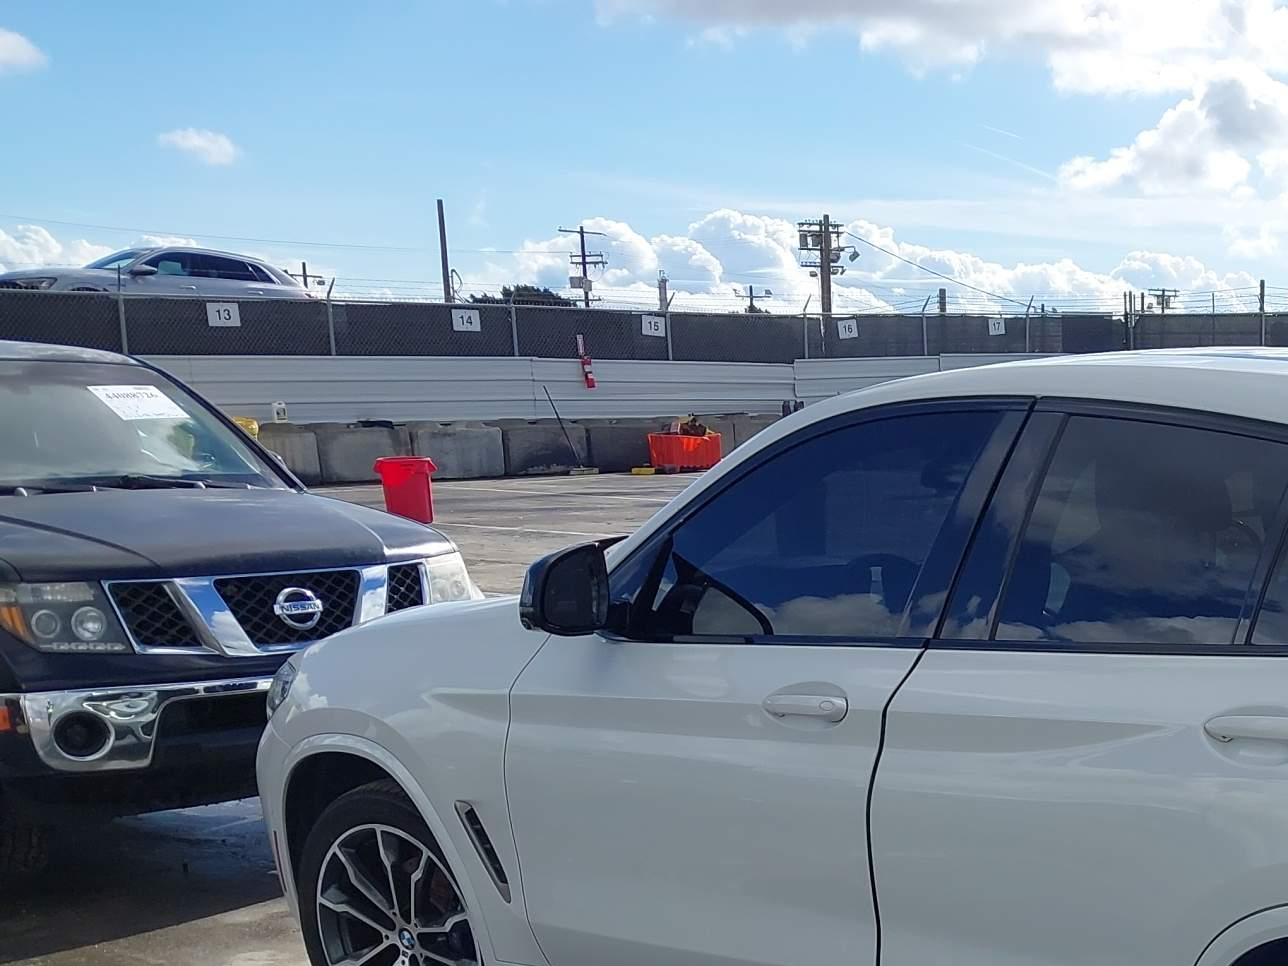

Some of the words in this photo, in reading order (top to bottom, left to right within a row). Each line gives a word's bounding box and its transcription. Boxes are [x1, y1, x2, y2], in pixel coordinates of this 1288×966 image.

[215, 309, 232, 321] 13
[459, 315, 473, 326] 14
[647, 320, 660, 332] 15
[842, 323, 854, 335] 16
[992, 321, 1001, 331] 17
[282, 601, 320, 613] NISSAN
